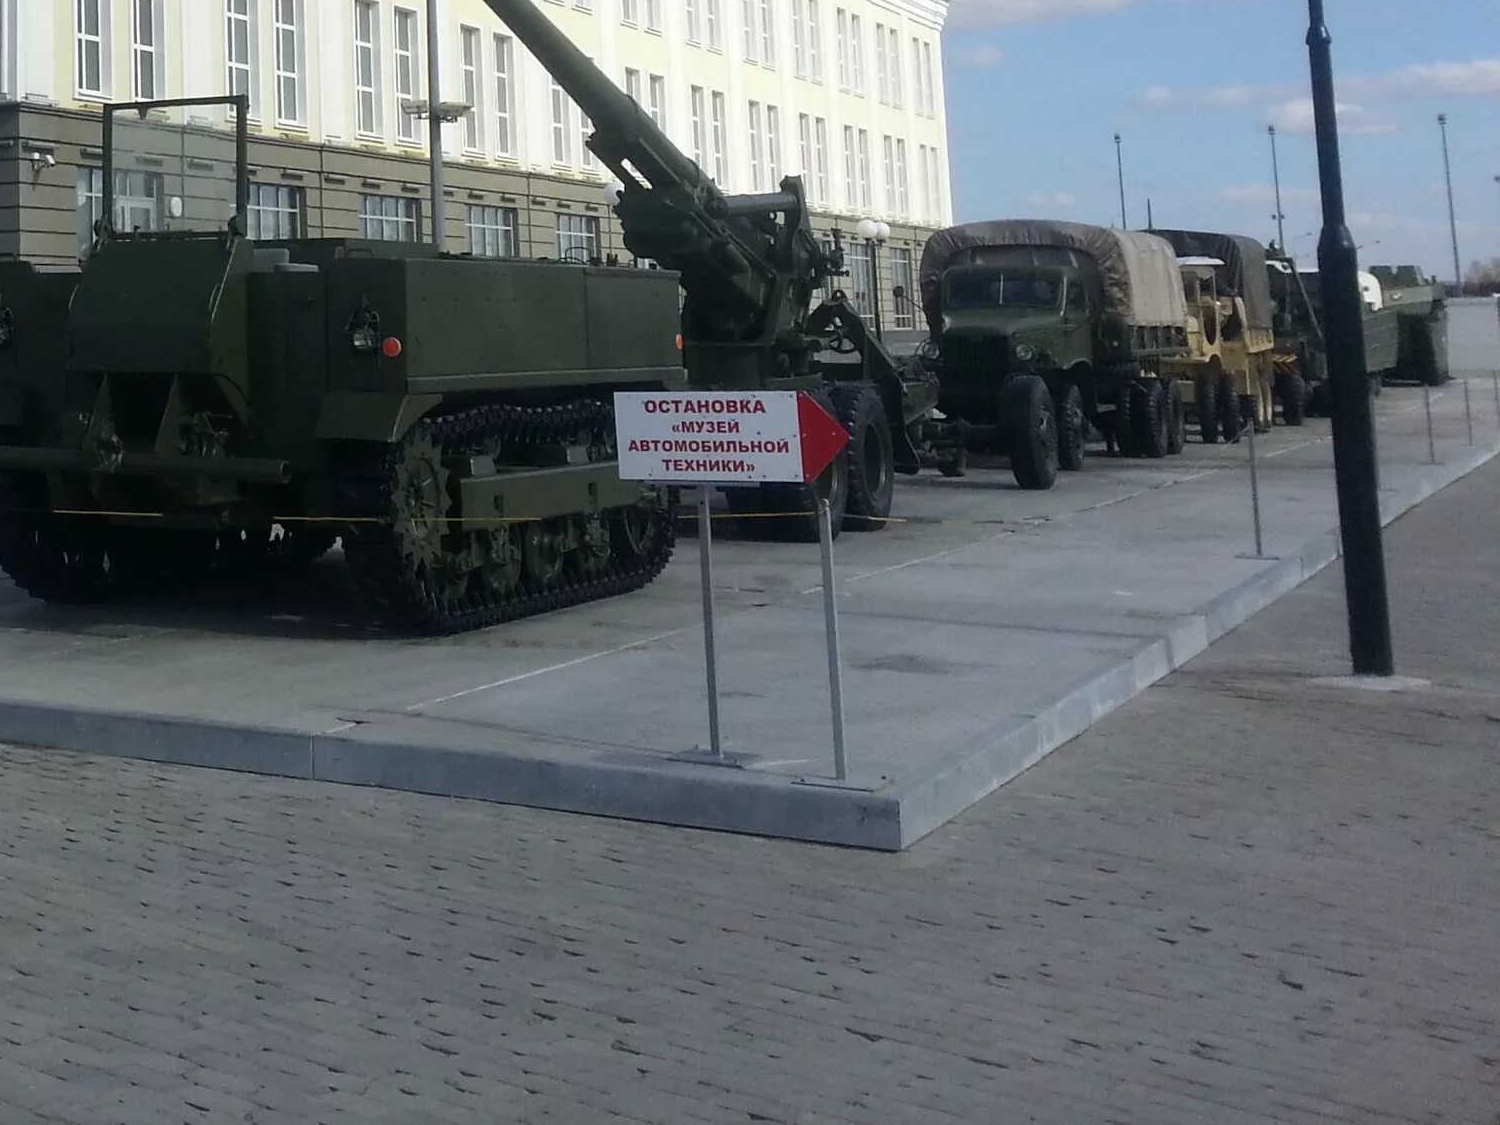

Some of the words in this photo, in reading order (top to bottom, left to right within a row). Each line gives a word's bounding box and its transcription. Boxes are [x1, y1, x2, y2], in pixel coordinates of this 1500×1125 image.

[644, 399, 766, 414] ОСТАНОВКА
[671, 419, 740, 434] «МУЗЕЙ
[628, 439, 789, 453] АВТОМОБИЛЬНОЙ
[662, 459, 755, 473] ТЕХНИКИ»
